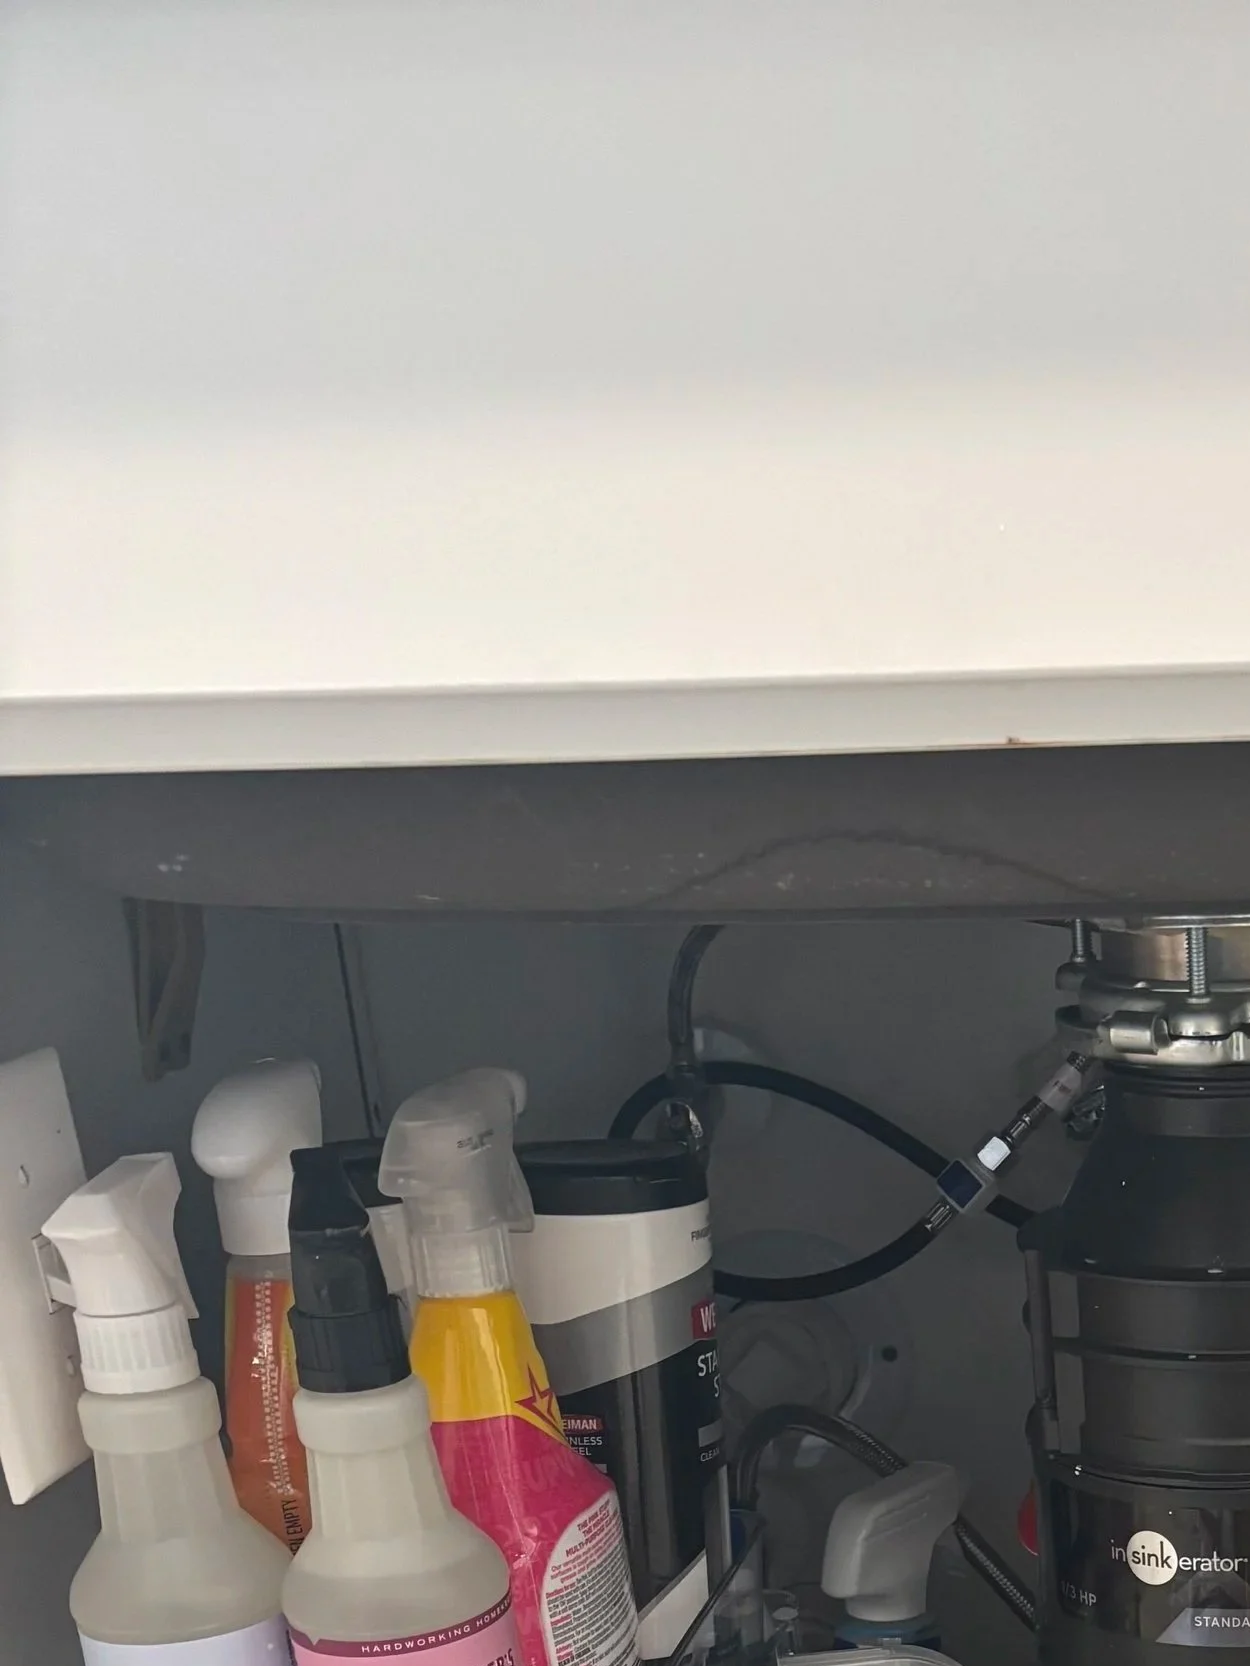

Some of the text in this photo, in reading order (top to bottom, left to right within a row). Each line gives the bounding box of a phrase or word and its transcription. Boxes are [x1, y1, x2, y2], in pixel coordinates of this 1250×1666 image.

[561, 1418, 597, 1430] EIMAN
[1079, 1591, 1097, 1606] HP
[362, 1625, 471, 1653] HARDWORKING
